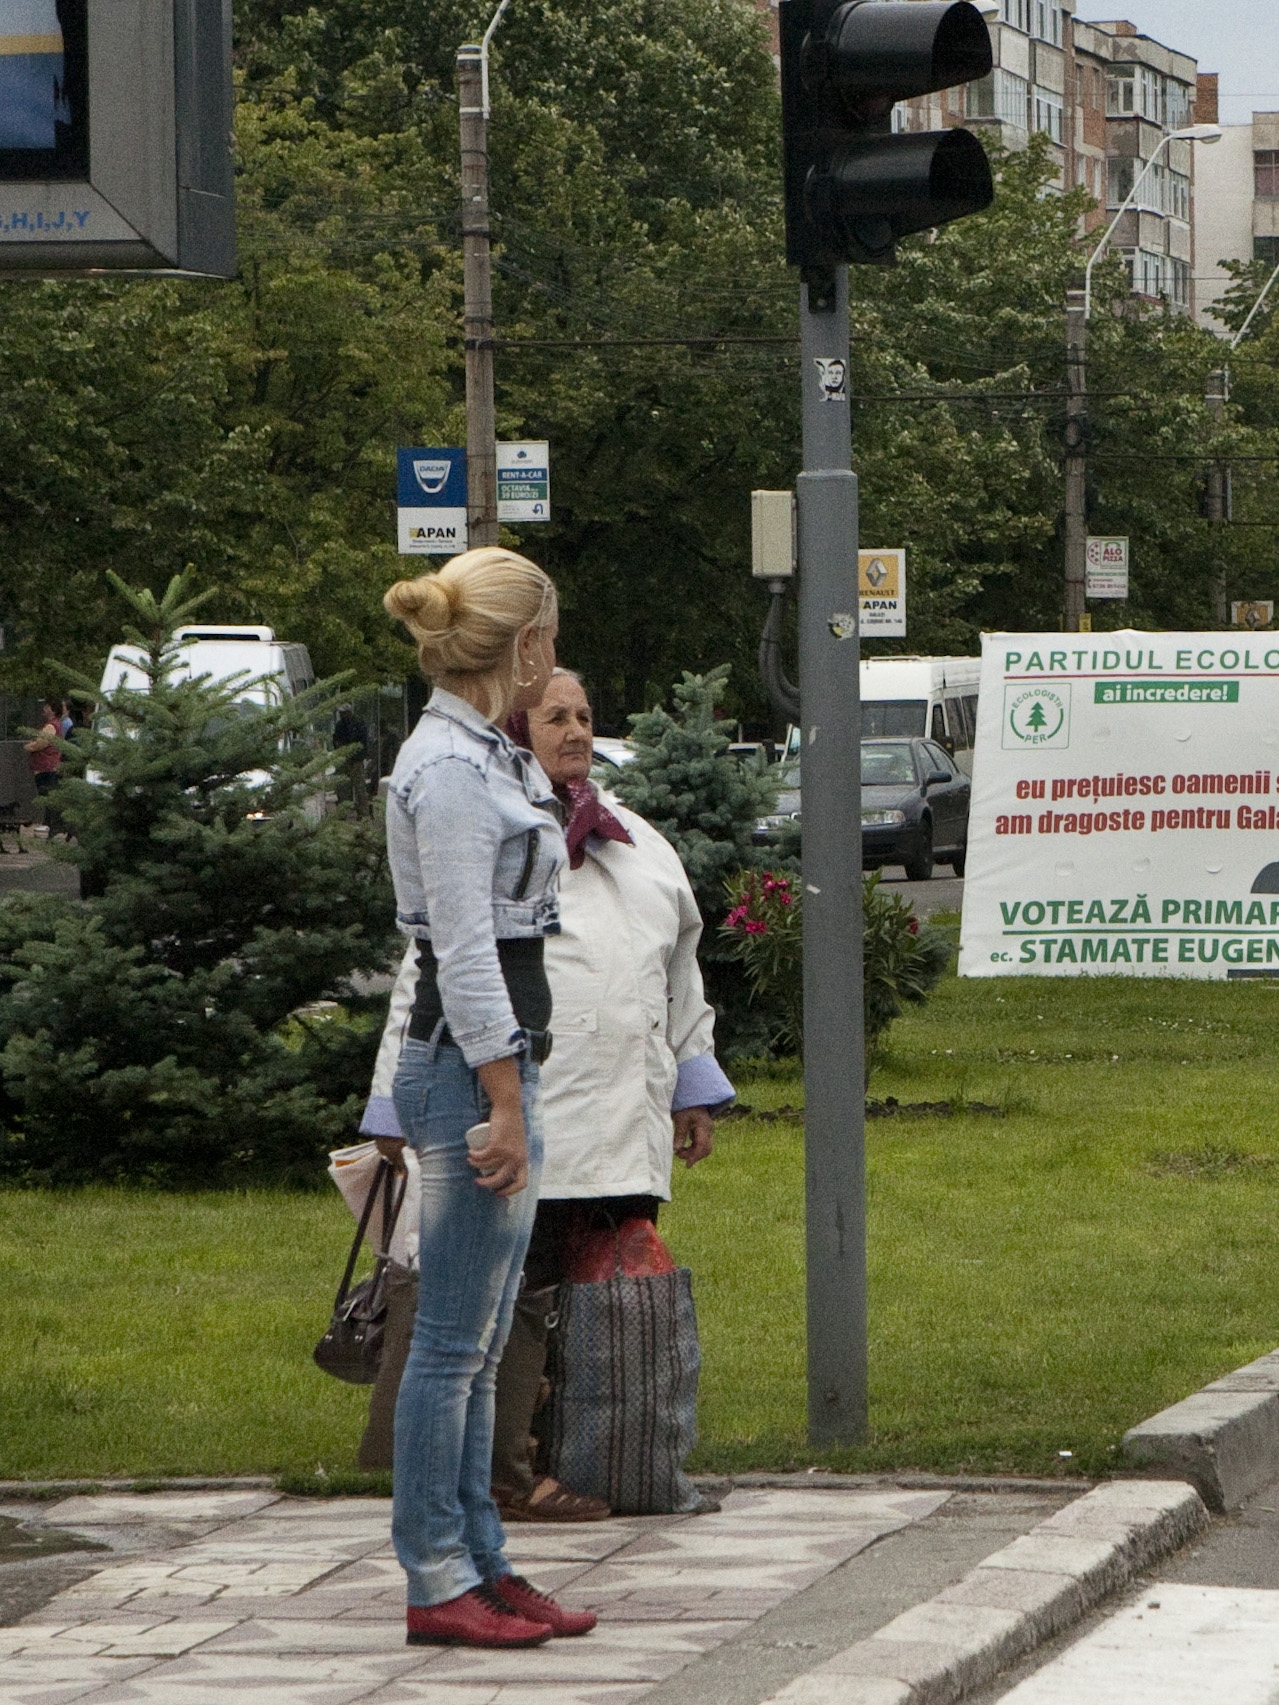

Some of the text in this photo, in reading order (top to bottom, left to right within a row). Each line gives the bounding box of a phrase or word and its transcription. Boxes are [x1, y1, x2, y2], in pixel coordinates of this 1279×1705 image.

[0, 211, 90, 233] ,H,I,J,Y
[502, 471, 543, 479] RENT-A-CAR
[416, 527, 456, 538] APAN
[1103, 548, 1122, 556] ALO
[863, 601, 897, 609] APAN
[1005, 650, 1163, 671] PARTIDUL
[1102, 684, 1229, 701] ai incredere!
[1024, 733, 1048, 744] PER
[1016, 779, 1046, 799] eu
[1051, 773, 1167, 804] prețuiesc
[1171, 771, 1270, 794] oamenii
[995, 812, 1032, 834] am
[1038, 808, 1145, 835] dragoste
[1151, 806, 1231, 832] pentru
[1000, 893, 1152, 925] VOTEAZĂ
[990, 951, 1013, 963] ec.
[1019, 938, 1170, 963] STAMATE
